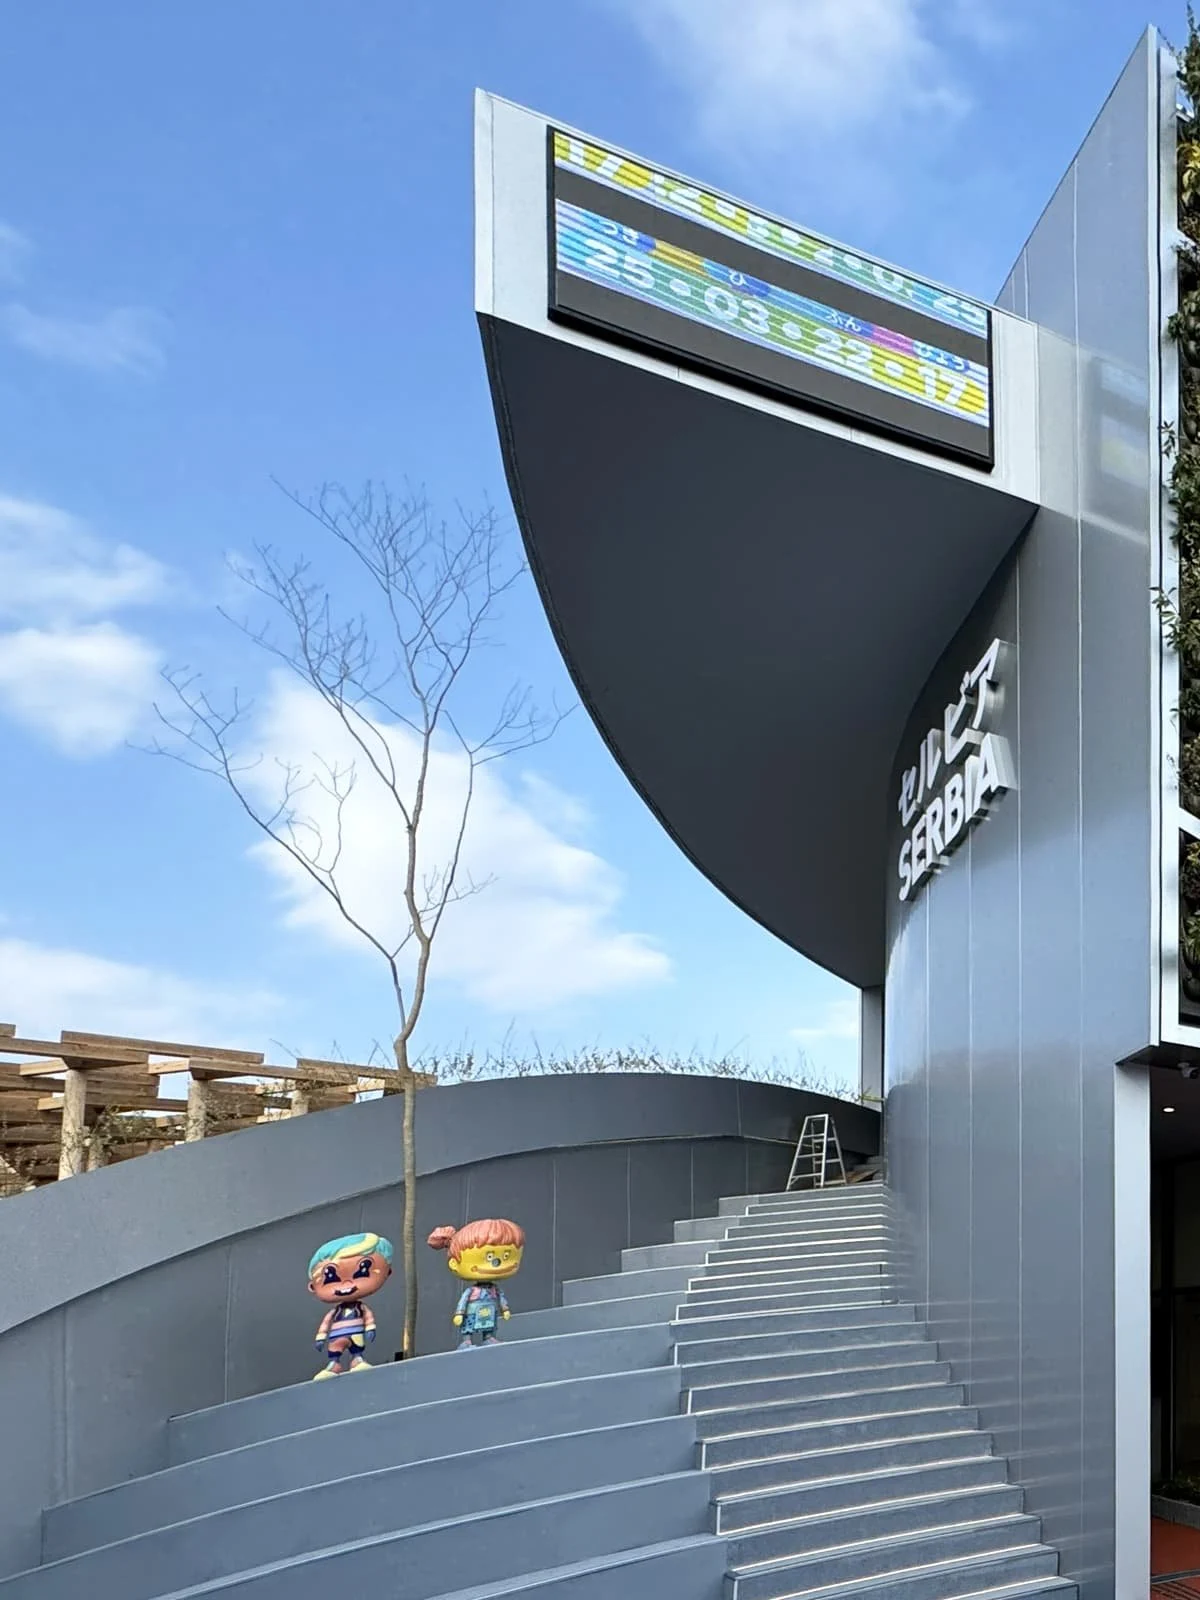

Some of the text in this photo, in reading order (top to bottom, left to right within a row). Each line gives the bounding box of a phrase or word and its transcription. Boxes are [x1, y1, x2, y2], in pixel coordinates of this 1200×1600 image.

[898, 638, 1004, 828] セルビア
[898, 732, 1006, 902] SERBIA
